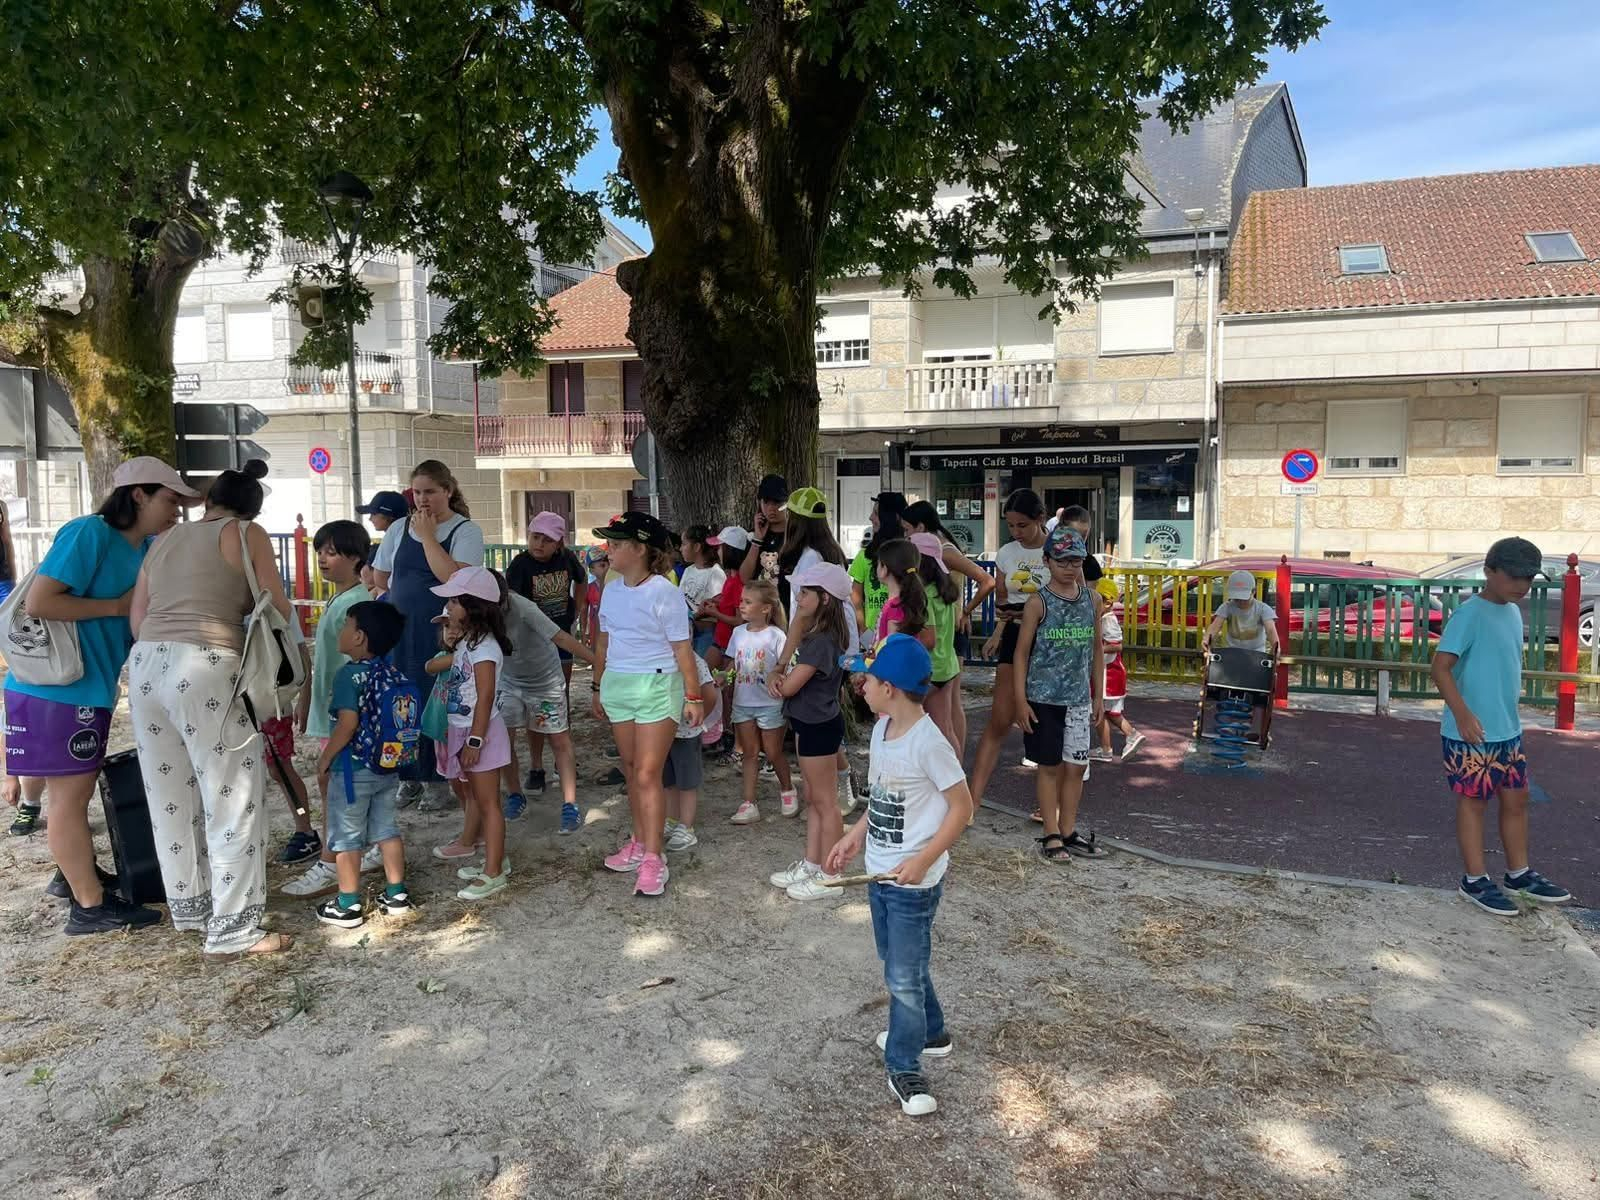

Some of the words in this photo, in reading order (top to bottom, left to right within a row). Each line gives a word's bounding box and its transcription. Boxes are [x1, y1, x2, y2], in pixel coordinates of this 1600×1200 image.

[942, 458, 978, 469] Tapería
[982, 457, 1006, 467] Café
[1011, 456, 1029, 466] Bar
[1035, 454, 1088, 465] Boulevard
[1093, 453, 1125, 463] Brasil
[1044, 628, 1069, 639] LONG
